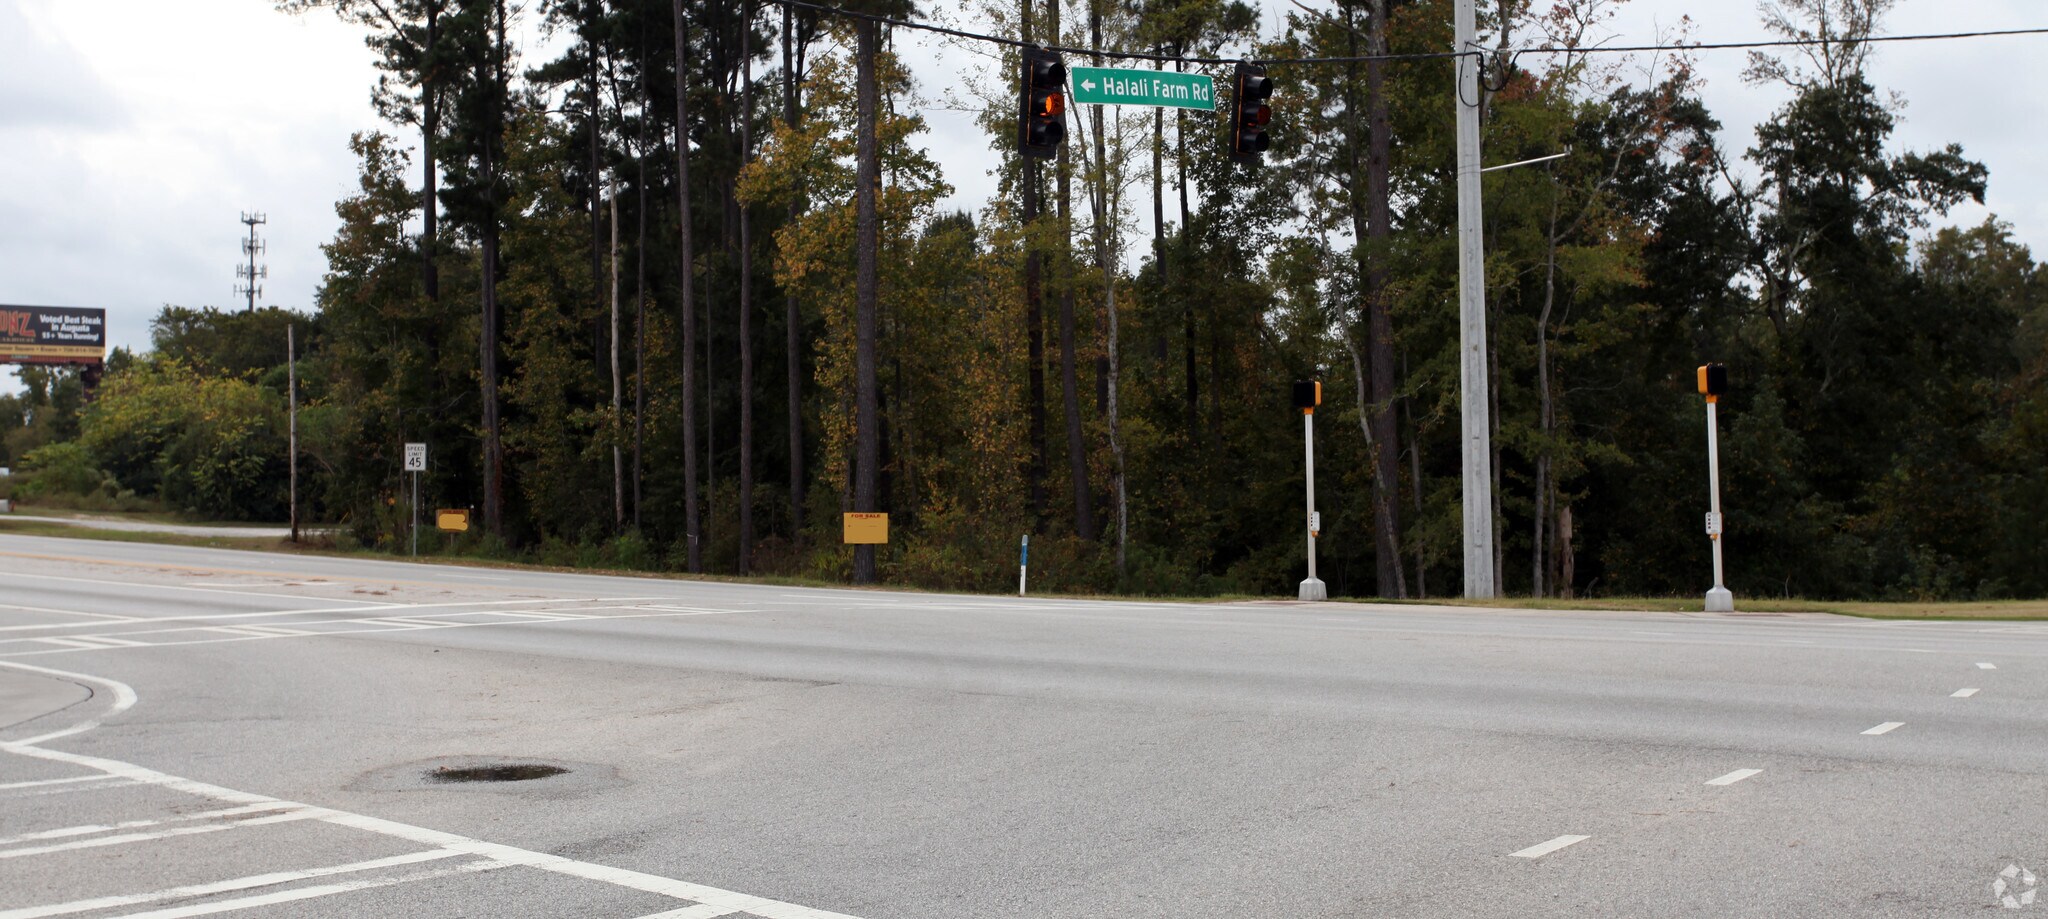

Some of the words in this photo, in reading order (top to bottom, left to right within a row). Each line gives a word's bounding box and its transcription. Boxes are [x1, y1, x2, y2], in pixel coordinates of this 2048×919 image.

[1103, 77, 1148, 97] Halali
[1153, 80, 1188, 99] Farm
[1192, 83, 1209, 101] Rd
[40, 314, 63, 323] Voted
[64, 315, 80, 324] Best
[81, 316, 102, 325] Steak
[61, 324, 90, 333] Augusta
[409, 457, 421, 467] 45
